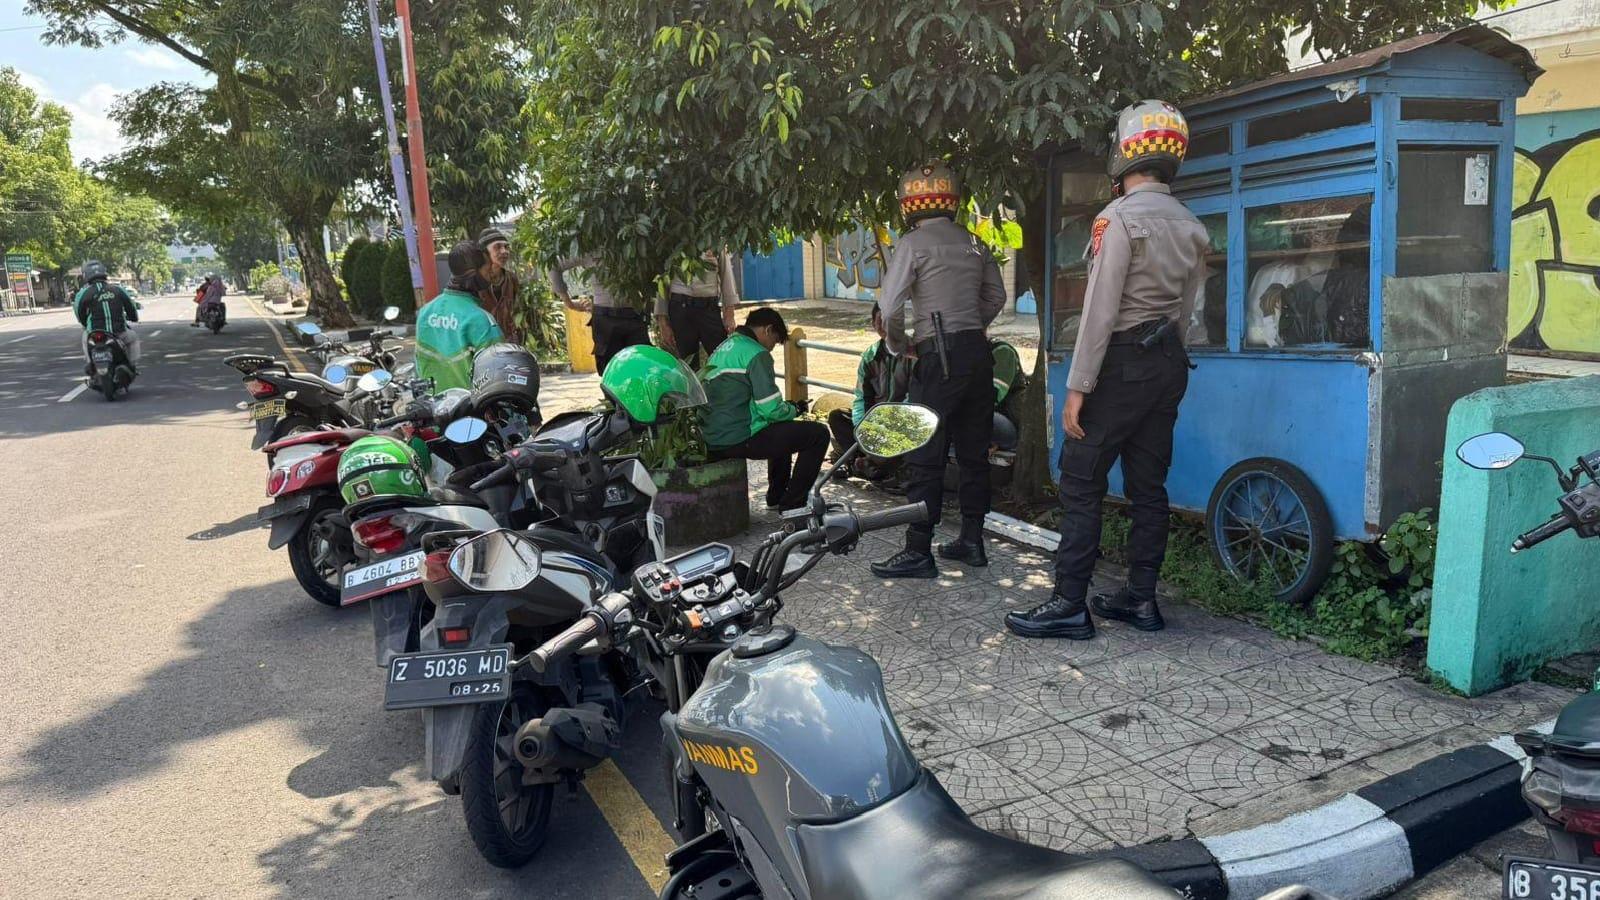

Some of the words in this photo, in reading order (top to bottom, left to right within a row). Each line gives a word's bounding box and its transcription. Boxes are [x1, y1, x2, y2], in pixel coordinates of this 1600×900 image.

[428, 312, 458, 330] Grab
[347, 575, 354, 586] B
[362, 562, 392, 580] 4604
[395, 662, 409, 681] Z
[424, 658, 467, 679] 5036
[478, 655, 503, 674] MD
[1514, 869, 1531, 898] B
